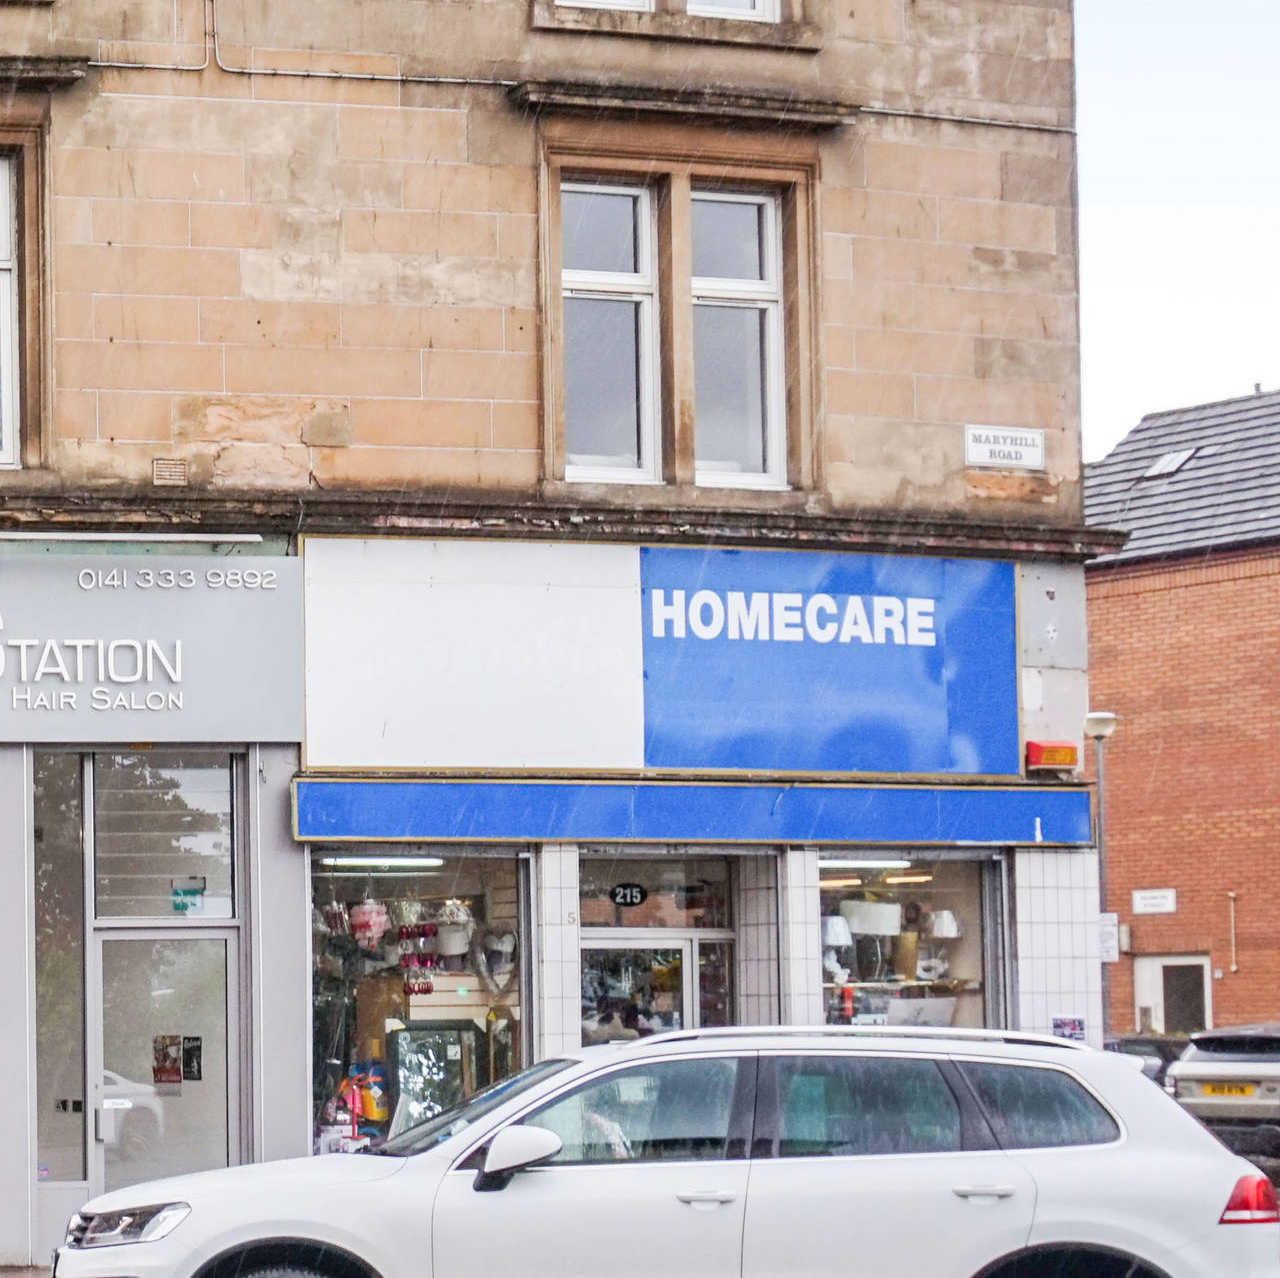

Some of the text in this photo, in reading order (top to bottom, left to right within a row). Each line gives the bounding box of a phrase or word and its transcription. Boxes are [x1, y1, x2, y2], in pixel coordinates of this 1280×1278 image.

[972, 433, 1039, 448] MARYHILL
[989, 449, 1023, 461] ROAD
[78, 568, 278, 591] 0141 333 9892
[650, 588, 937, 646] HOMECARE
[615, 887, 641, 904] 215
